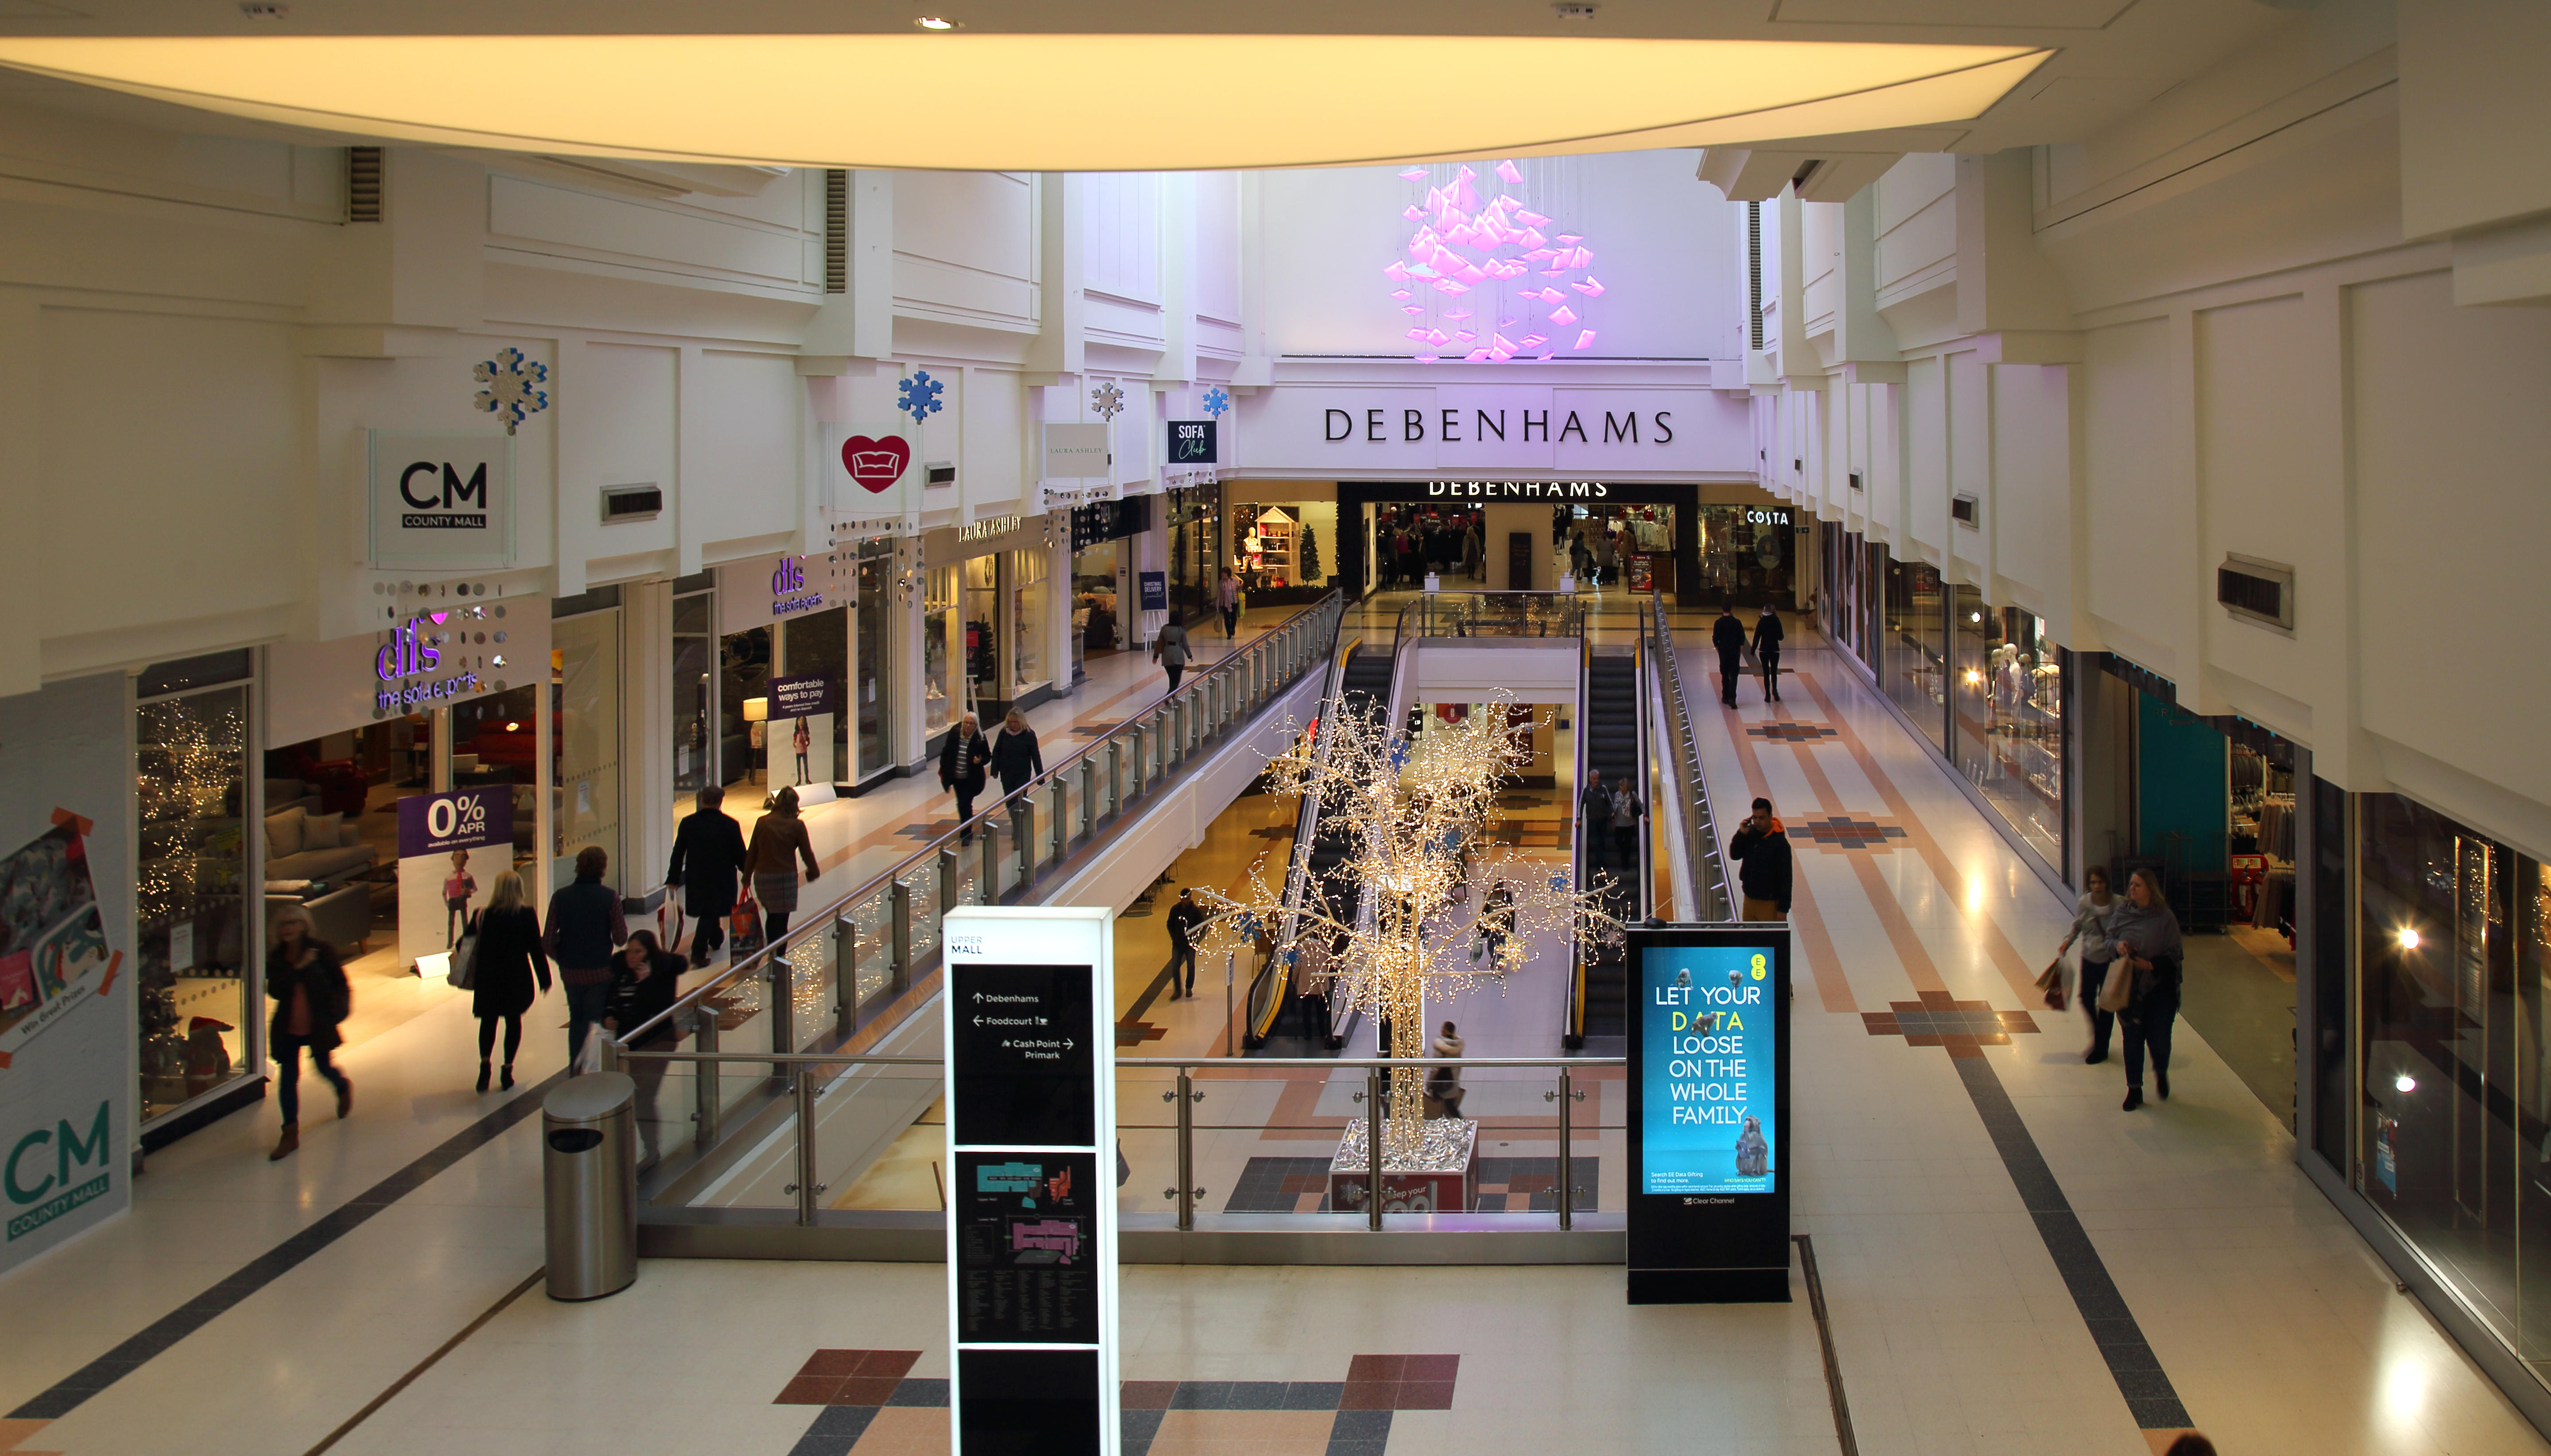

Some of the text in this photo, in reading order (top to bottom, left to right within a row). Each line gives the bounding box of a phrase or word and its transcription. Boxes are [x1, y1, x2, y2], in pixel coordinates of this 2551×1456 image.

[1179, 425, 1204, 439] SOFA
[1325, 409, 1673, 443] DEBENHAMS
[1179, 440, 1206, 459] Club
[400, 461, 487, 509] CM
[1429, 481, 1607, 496] DEBENHAMS
[405, 516, 484, 526] COUNTY MALL
[1747, 511, 1788, 526] COSTA
[959, 520, 987, 542] LAURA
[990, 516, 1021, 536] ASHLEY
[774, 601, 785, 615] the
[801, 593, 822, 610] experts
[778, 679, 824, 692] comfortable
[379, 689, 400, 709] the
[779, 693, 799, 702] ways
[809, 689, 823, 699] pay
[428, 794, 485, 838] 0%
[457, 821, 485, 835] APR
[951, 945, 983, 954] MALL
[986, 995, 1039, 1003] Debenhams
[1656, 986, 1760, 1005] LET YOUR
[986, 1017, 1032, 1026] Foodcourt
[1013, 1040, 1060, 1048] Cash Point
[1673, 1036, 1743, 1054] LOOSE
[1669, 1059, 1746, 1078] ON THE
[1670, 1083, 1747, 1101] WHOLE
[1673, 1106, 1747, 1124] FAMILY
[4, 1099, 109, 1205] CM
[1392, 1186, 1427, 1200] eep your
[10, 1178, 106, 1236] COUNTY MALL
